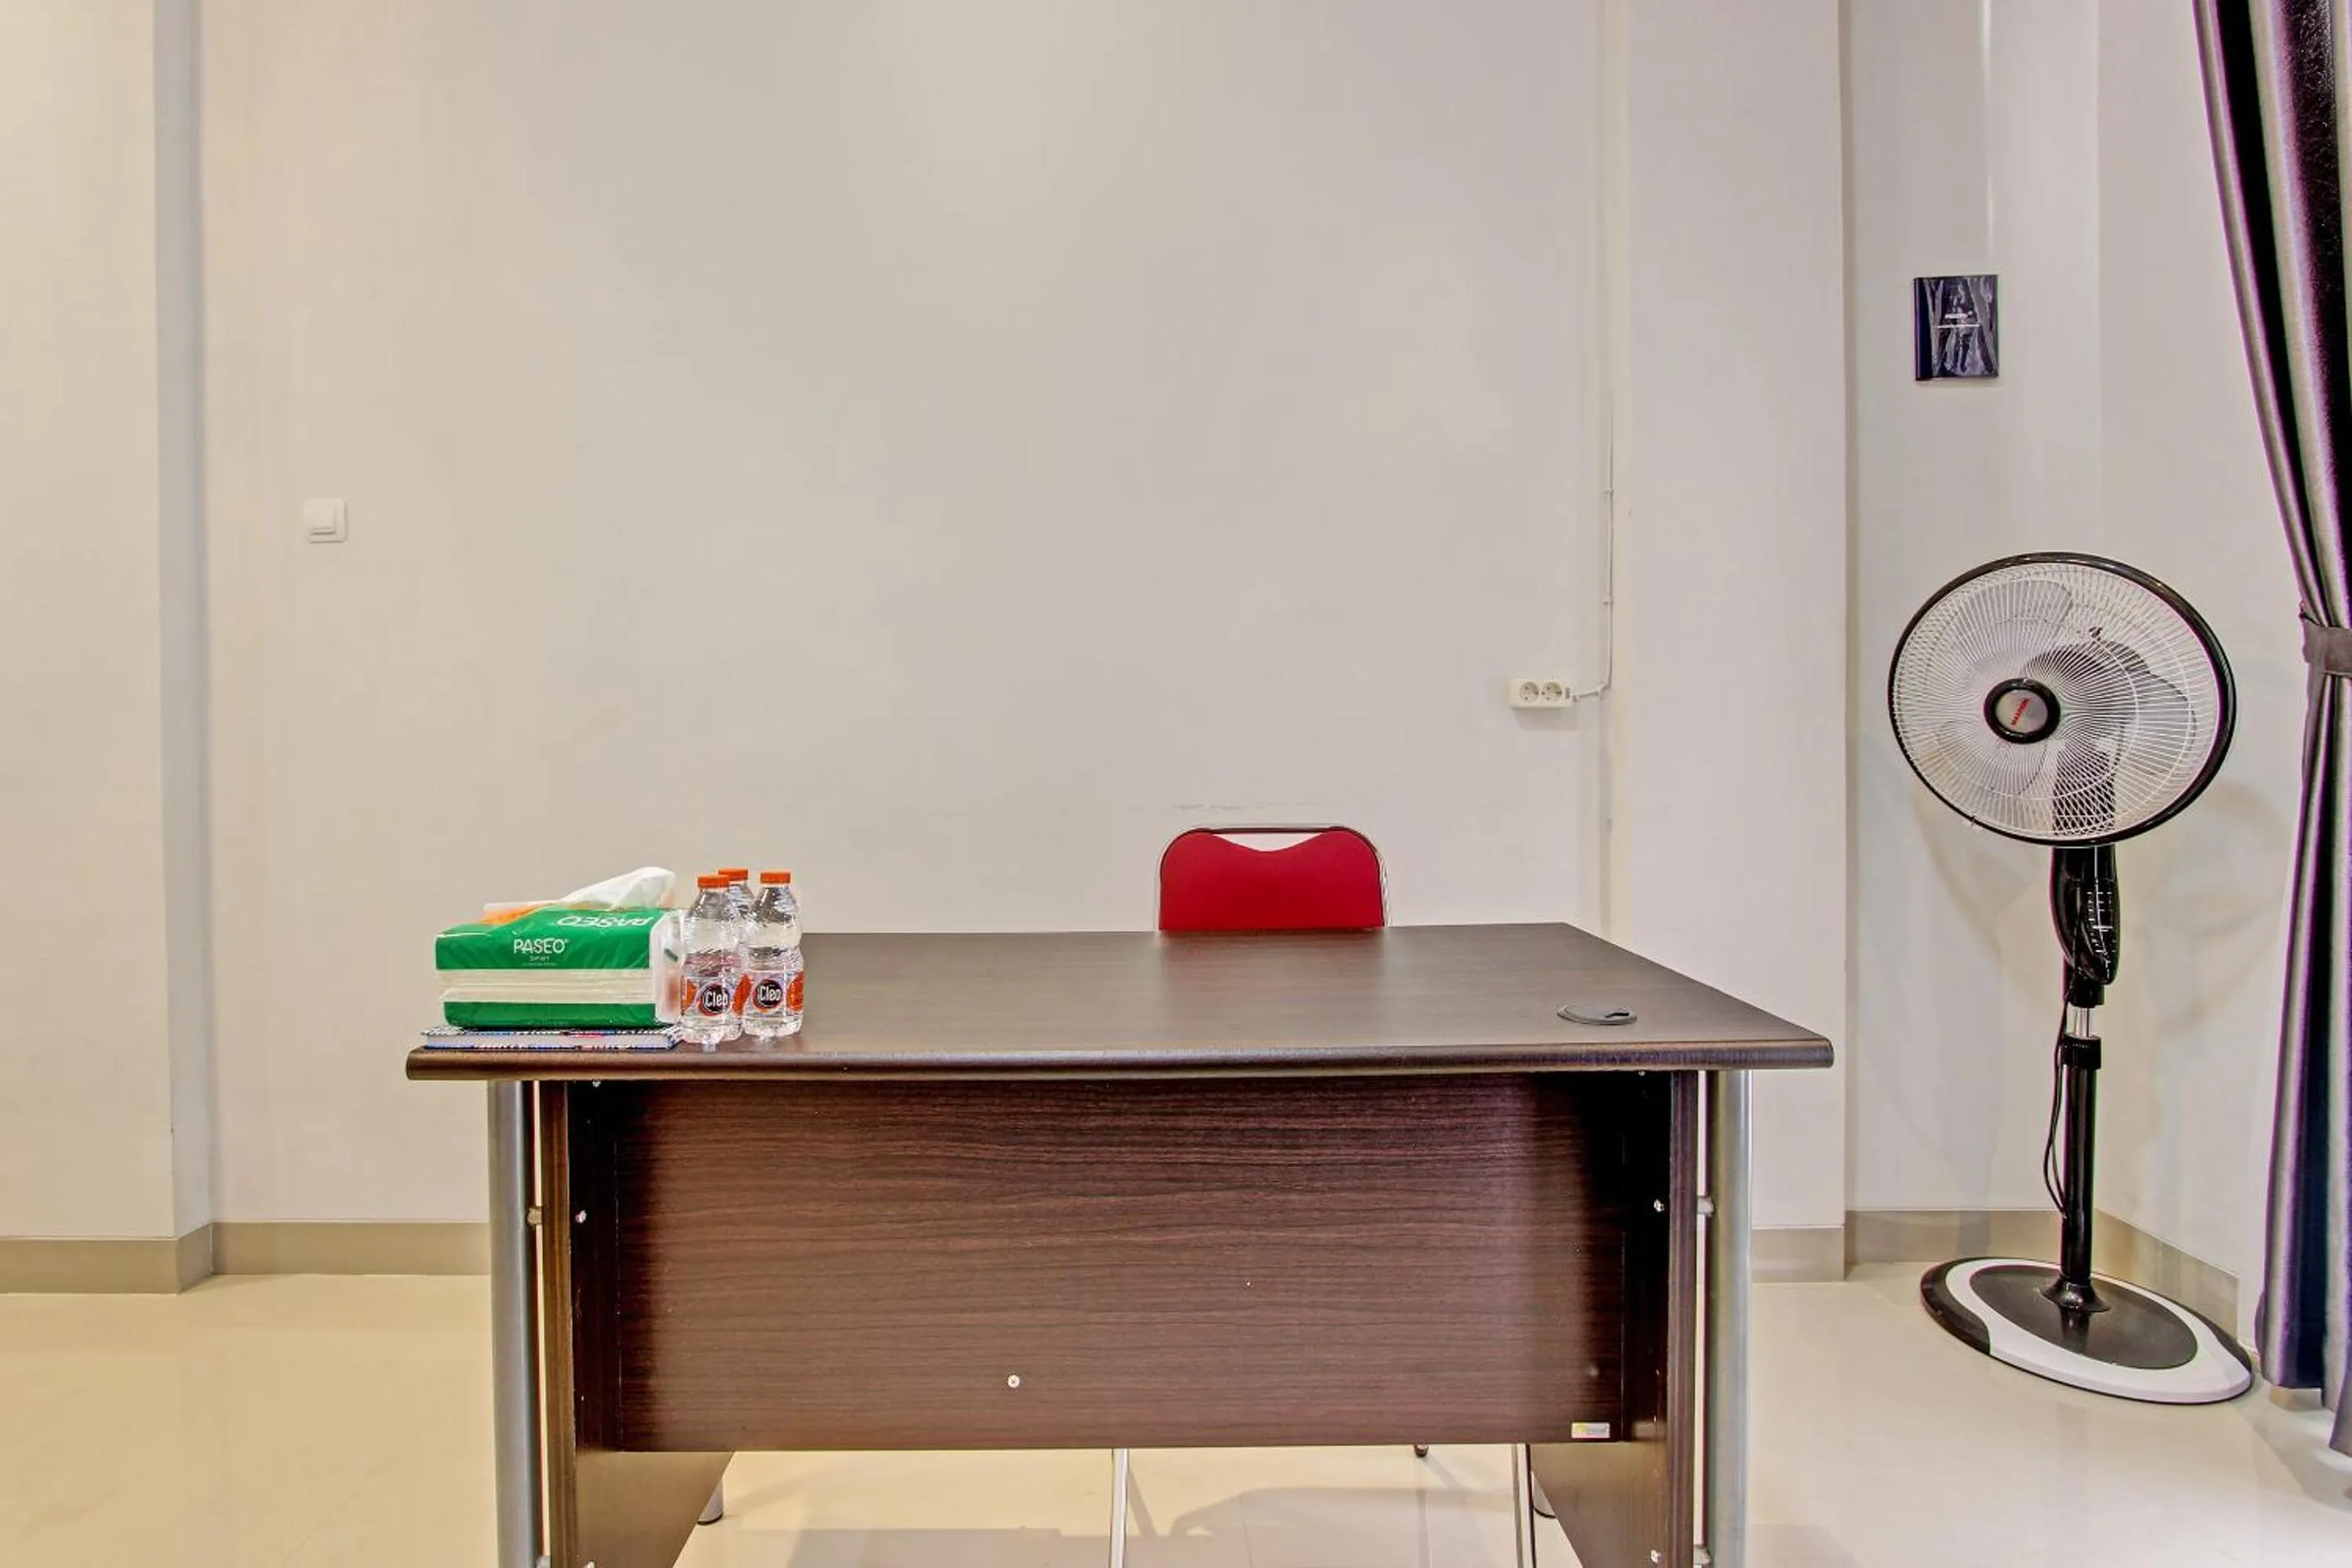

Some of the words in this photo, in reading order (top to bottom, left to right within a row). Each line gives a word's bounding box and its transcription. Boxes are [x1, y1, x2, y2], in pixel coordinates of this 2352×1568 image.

[556, 915, 654, 927] PASEO
[513, 938, 566, 954] PASEO
[704, 990, 728, 1007] Cleo
[759, 984, 782, 1001] Cleo
